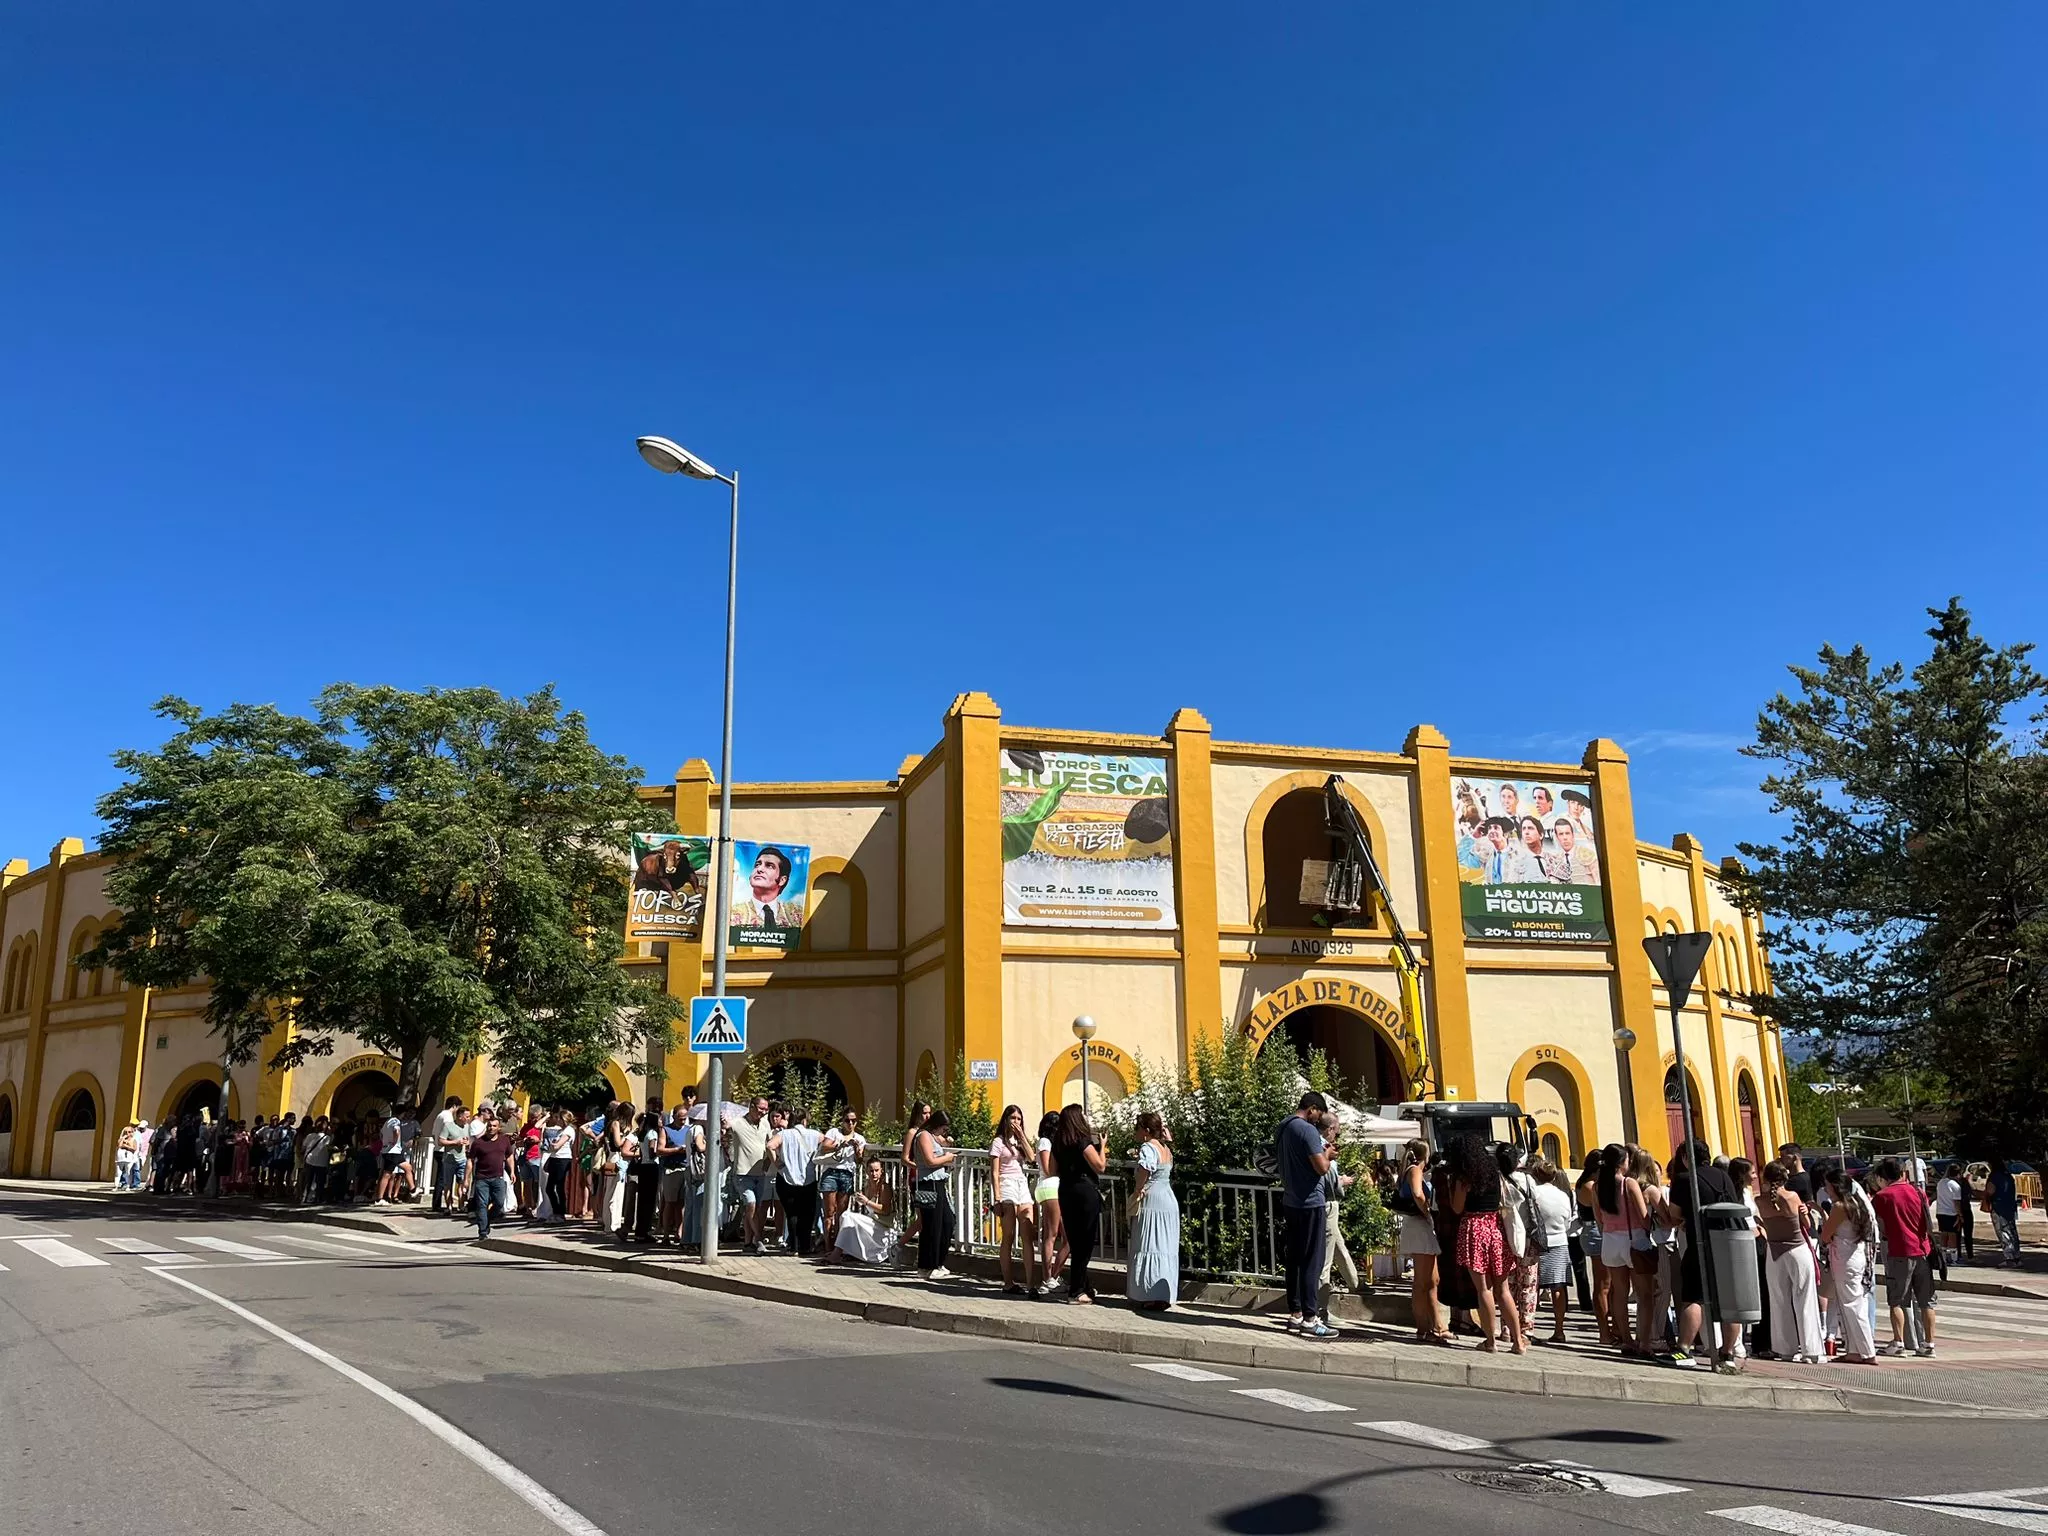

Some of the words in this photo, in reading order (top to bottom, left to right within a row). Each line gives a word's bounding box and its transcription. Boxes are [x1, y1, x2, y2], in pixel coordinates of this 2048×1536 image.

[1044, 759, 1101, 771] TOROS
[1107, 763, 1129, 772] EN
[1000, 768, 1168, 796] HUESCA
[1073, 831, 1126, 851] FIESTA
[1046, 885, 1057, 893] 2
[1078, 886, 1096, 894] 15
[1116, 889, 1159, 897] AGOSTO
[1484, 889, 1512, 899] LAS
[1516, 889, 1582, 901] MÁXIMAS
[632, 888, 703, 913] TOROS
[1485, 899, 1583, 916] FIGURAS
[631, 913, 699, 925] HUESCA
[740, 931, 787, 940] MORANTE
[1484, 928, 1512, 937] 20%
[1530, 931, 1592, 939] DESCUENTO
[1243, 985, 1309, 1044] PLAZA
[1312, 981, 1342, 1001] DE
[1348, 984, 1406, 1041] TOROS
[1536, 1048, 1560, 1060] SOL
[341, 1057, 376, 1075] PUERTA
